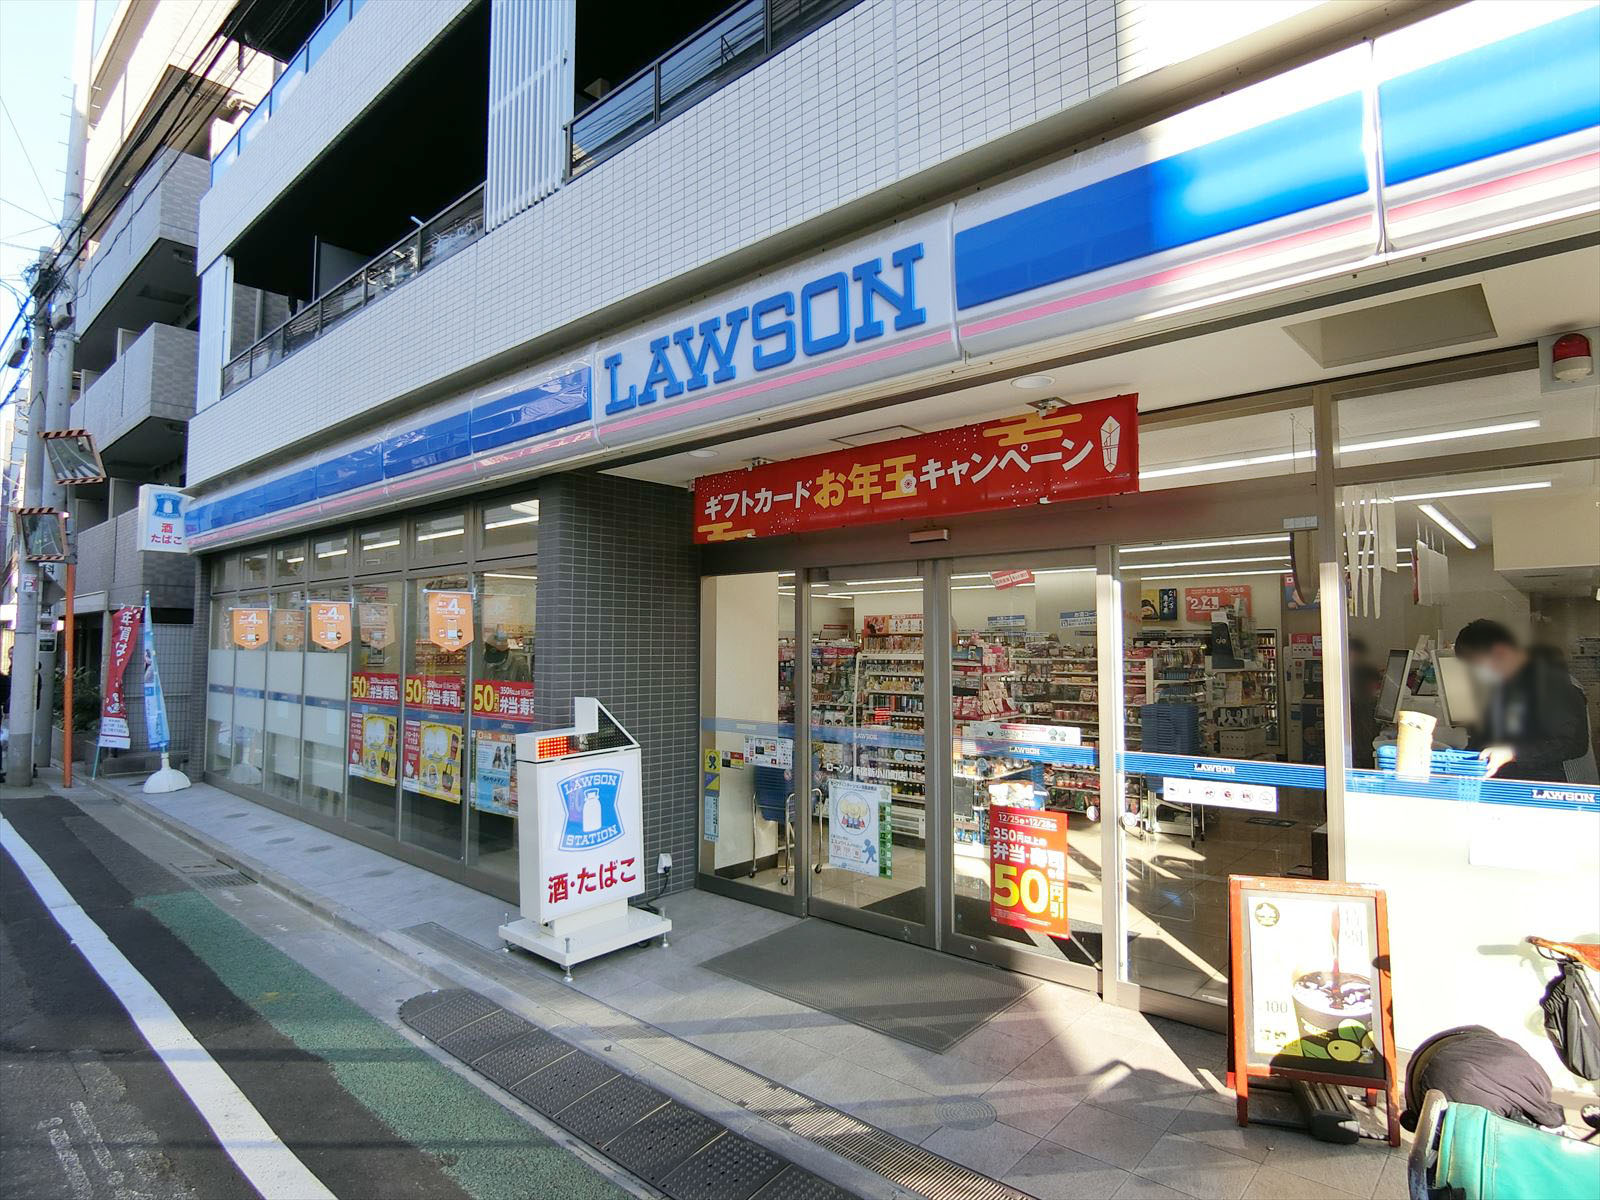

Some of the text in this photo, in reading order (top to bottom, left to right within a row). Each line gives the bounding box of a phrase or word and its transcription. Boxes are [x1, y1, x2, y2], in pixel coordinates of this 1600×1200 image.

[604, 242, 926, 416] LAWSON
[161, 522, 174, 533] 酒
[151, 533, 182, 545] たばこ
[352, 676, 366, 698] 50
[406, 679, 422, 703] 50
[474, 684, 493, 712] 50
[1009, 746, 1040, 755] LAWSON
[1194, 763, 1236, 774] LAWSON
[564, 774, 617, 795] LAWSON
[1531, 789, 1596, 803] LAWSON
[565, 824, 618, 846] STATION
[548, 857, 636, 904] 酒・たばこ
[993, 863, 1048, 914] 50
[1265, 1000, 1289, 1014] 100
